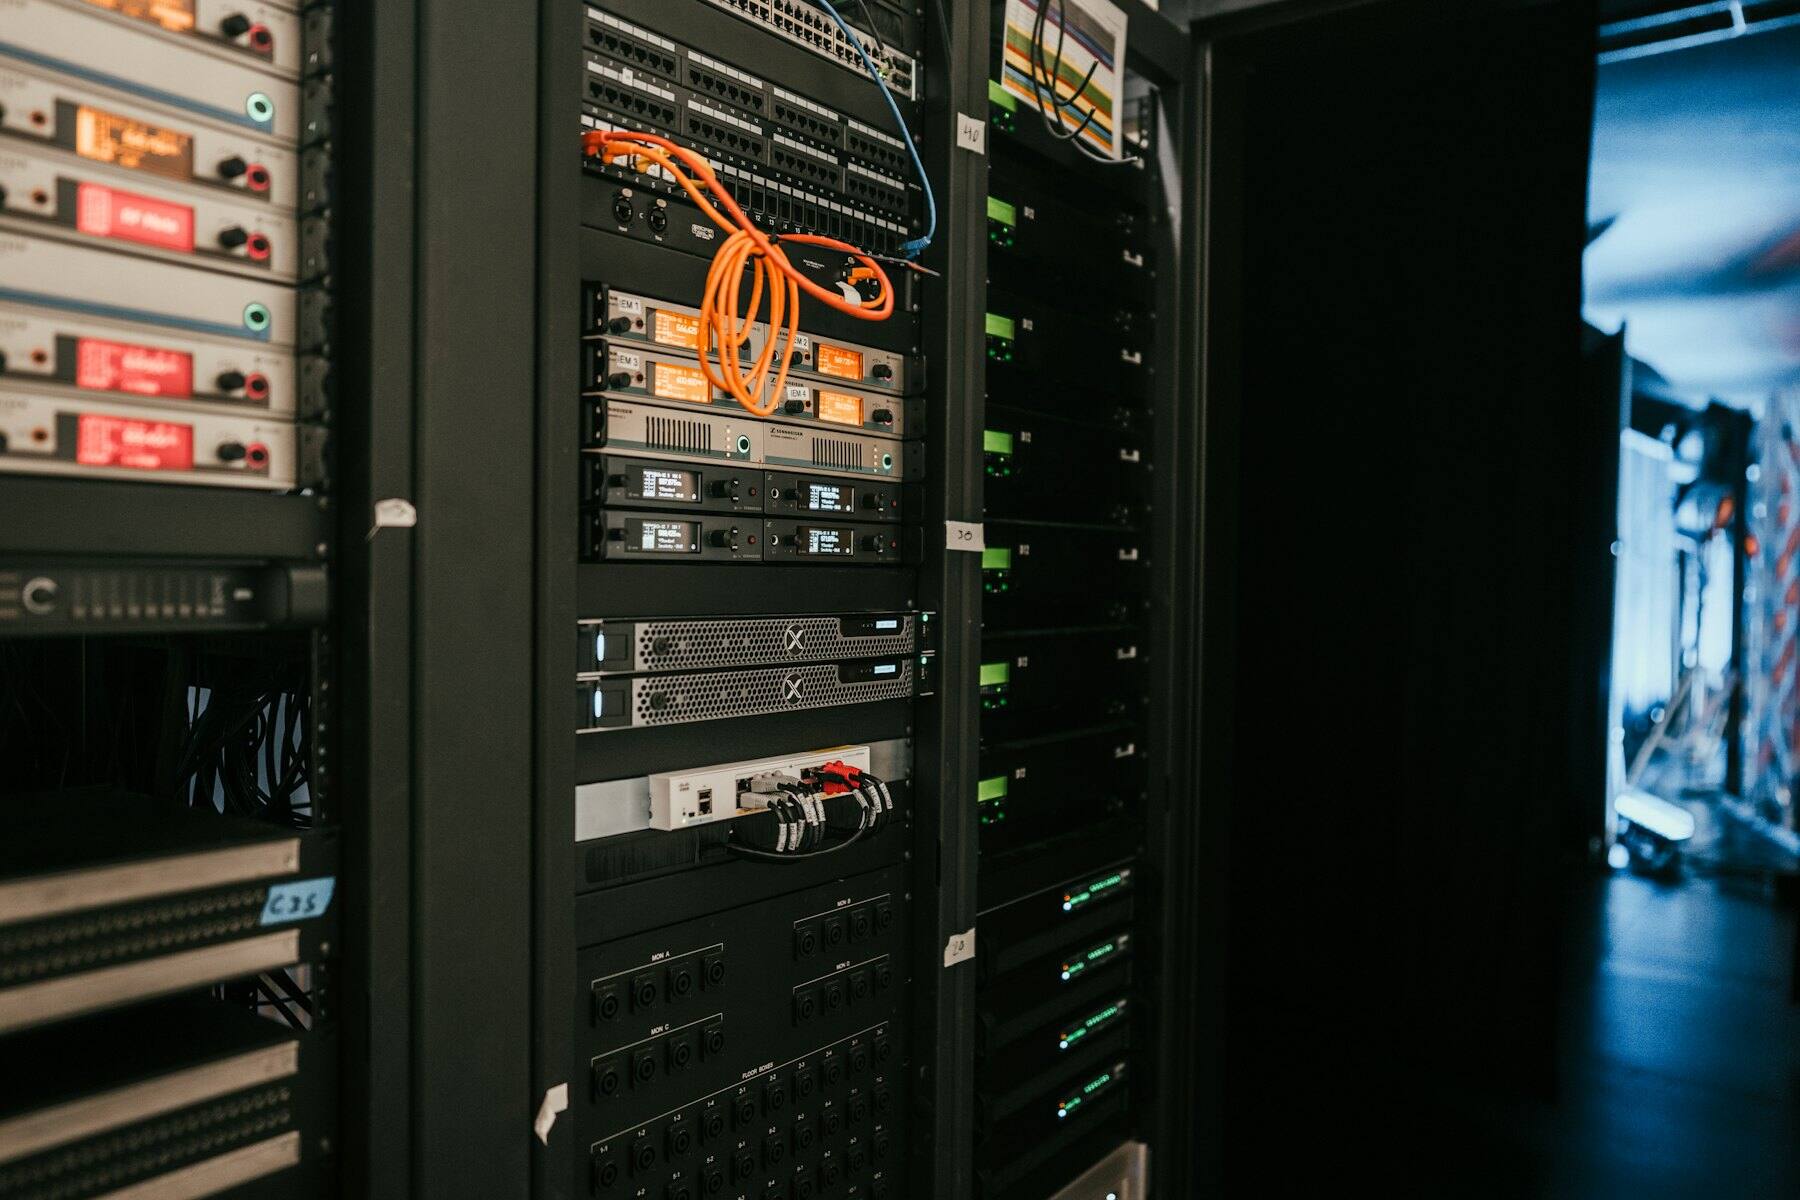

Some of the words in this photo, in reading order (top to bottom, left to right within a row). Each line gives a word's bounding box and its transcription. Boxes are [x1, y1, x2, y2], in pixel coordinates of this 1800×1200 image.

[755, 214, 761, 222] 12
[769, 218, 775, 226] 13
[958, 529, 973, 541] 30
[651, 951, 665, 963] MON
[650, 1024, 664, 1036] MON
[741, 1068, 758, 1080] FLOOR
[758, 1061, 774, 1073] BOXES
